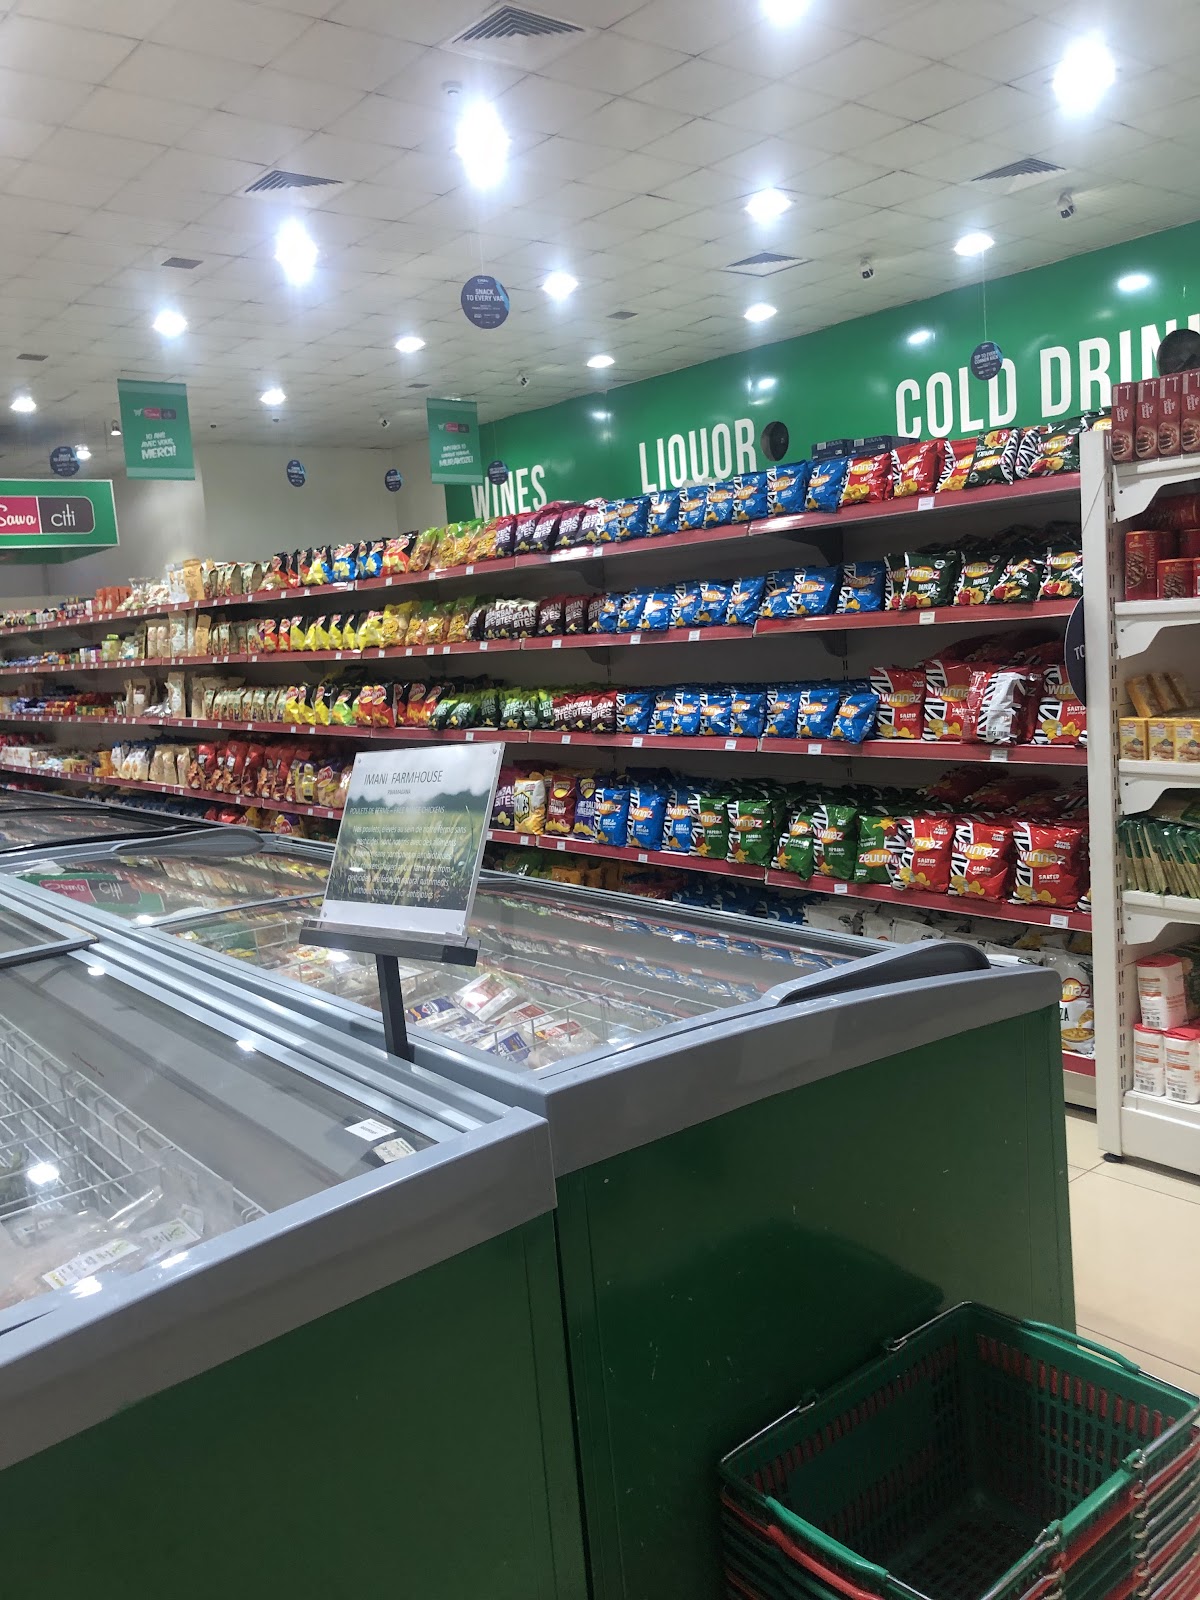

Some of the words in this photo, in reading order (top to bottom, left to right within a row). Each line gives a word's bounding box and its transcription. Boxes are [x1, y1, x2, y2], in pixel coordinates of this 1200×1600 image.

[896, 358, 1017, 439] COLD
[1040, 314, 1200, 418] DRIN
[141, 445, 176, 460] MERCI!
[639, 418, 757, 494] LIQUOR
[953, 457, 974, 469] winn
[471, 464, 547, 523] WINES
[0, 504, 36, 527] Sawa
[51, 503, 76, 527] citi
[889, 570, 908, 580] win
[907, 568, 941, 579] winnaz
[962, 565, 994, 575] winnaz
[795, 583, 825, 592] winnaz
[513, 617, 536, 628] BITES
[934, 686, 971, 698] winna
[1048, 684, 1074, 695] win
[881, 690, 922, 704] winnaz
[591, 708, 612, 720] BITES
[801, 704, 827, 713] winnaz
[364, 773, 389, 785] IMANI
[391, 770, 443, 784] FARMHOUSE
[595, 803, 621, 812] winnaz
[959, 842, 1000, 858] winnaz
[859, 853, 899, 865] winnaz
[1019, 850, 1066, 865] winnaz
[1060, 1007, 1069, 1021] ZA
